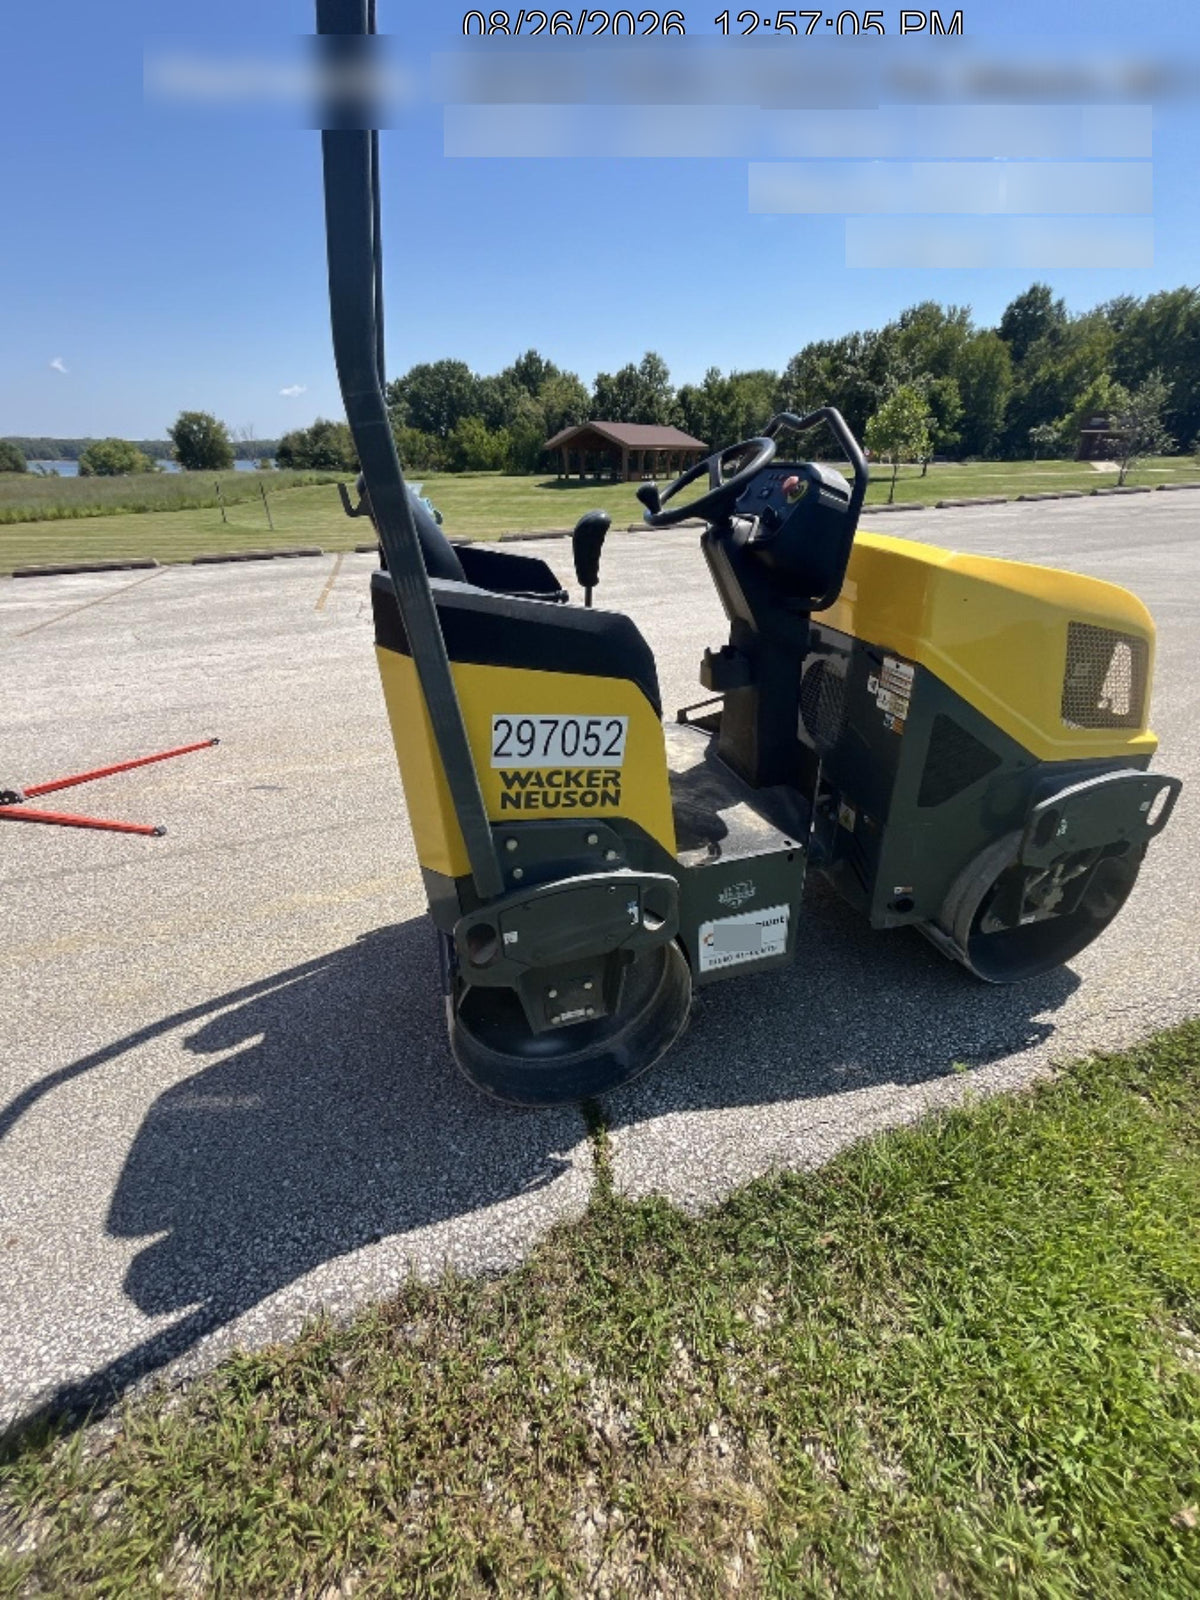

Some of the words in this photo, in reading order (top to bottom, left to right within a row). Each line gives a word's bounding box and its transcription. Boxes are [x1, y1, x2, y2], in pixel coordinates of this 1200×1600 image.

[493, 719, 624, 758] 297052
[499, 769, 621, 789] WACKER
[501, 789, 621, 810] NEUSON
